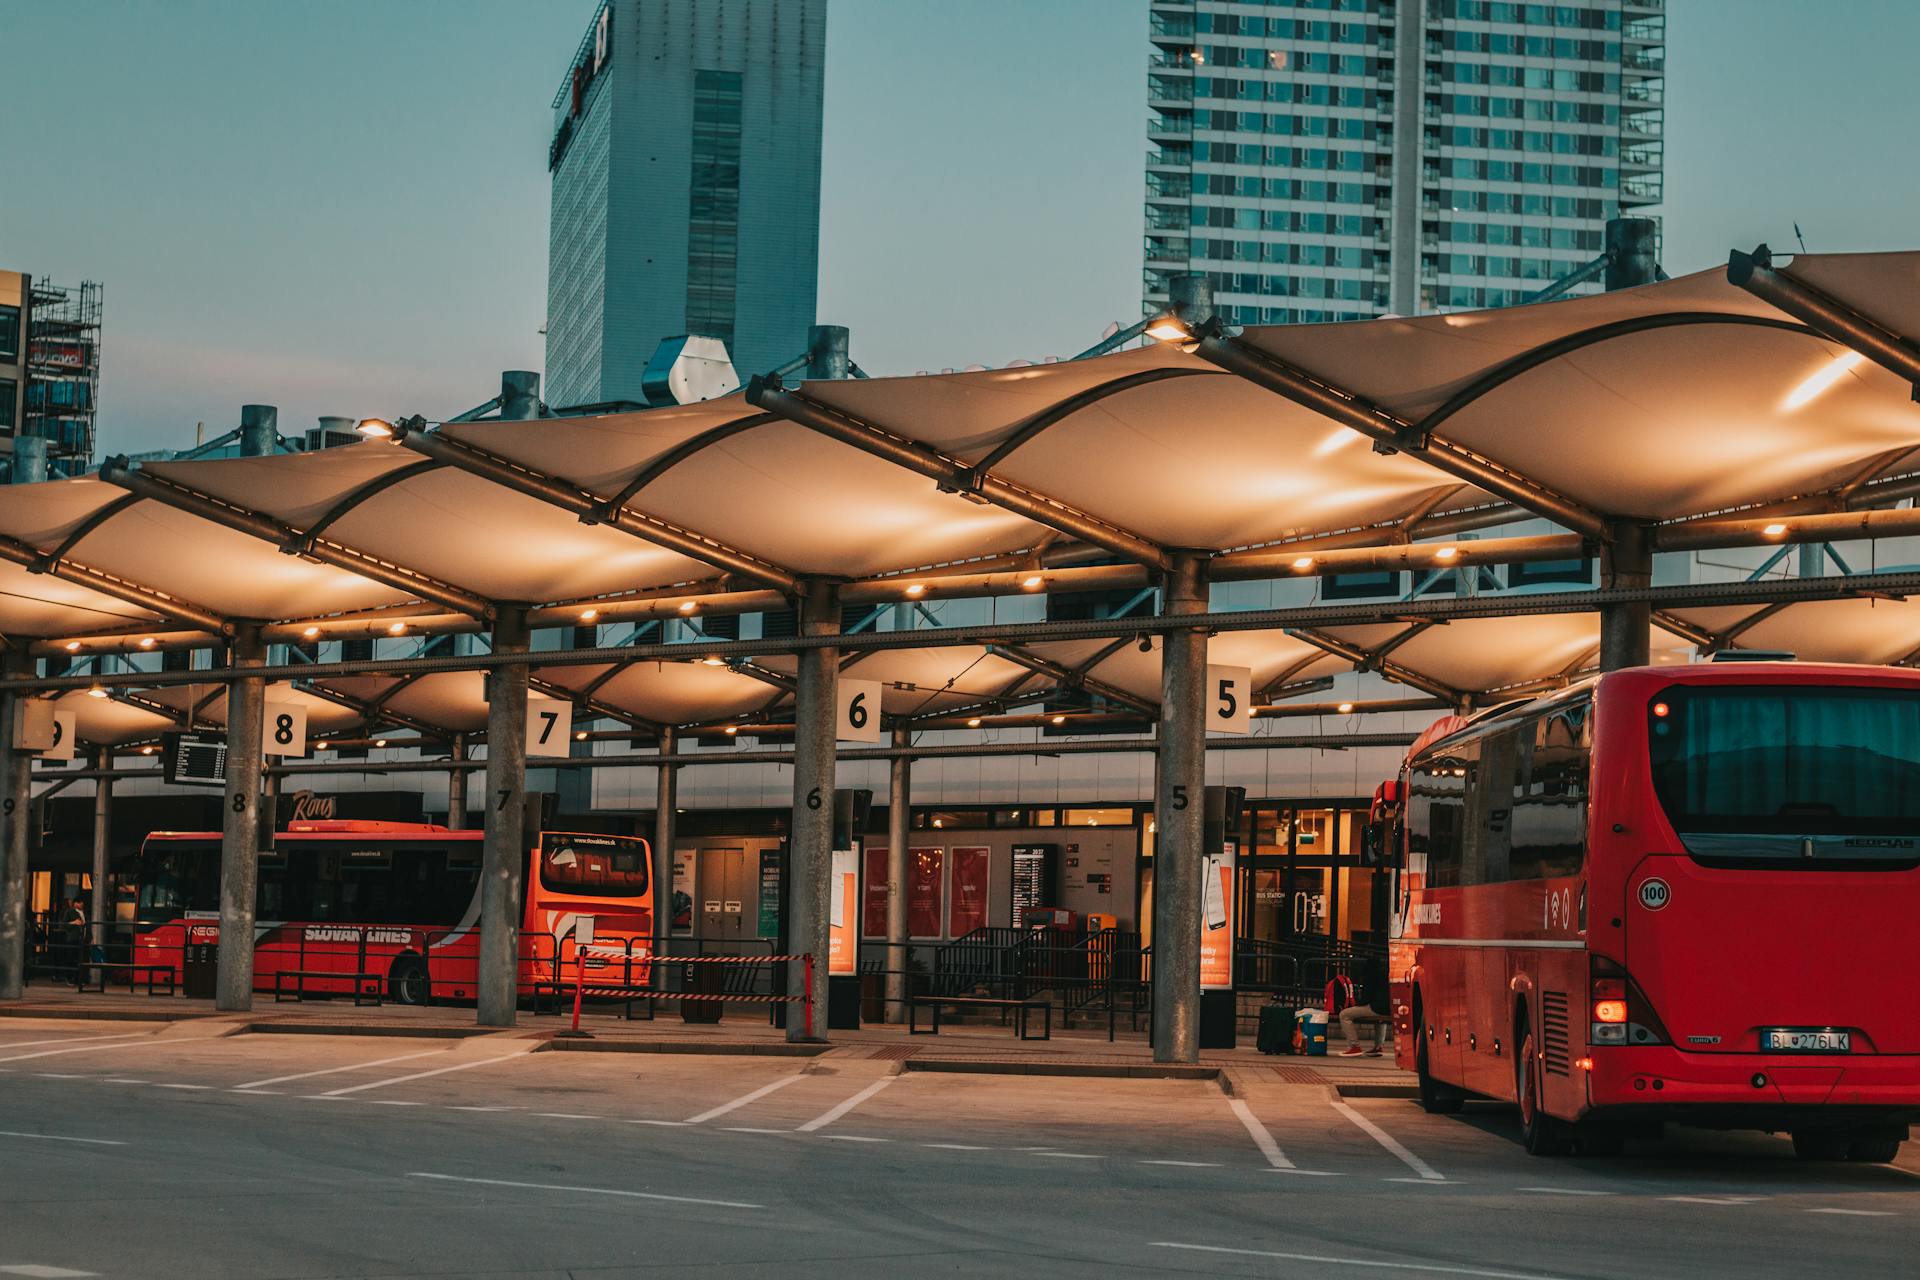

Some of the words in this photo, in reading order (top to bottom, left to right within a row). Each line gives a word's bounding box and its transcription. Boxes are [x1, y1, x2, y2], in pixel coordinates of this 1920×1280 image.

[849, 692, 867, 728] 6
[1218, 680, 1236, 719] 5
[275, 714, 293, 744] 8
[539, 712, 558, 744] 7
[4, 798, 15, 816] 9
[232, 793, 245, 812] 8
[497, 790, 511, 811] 7
[807, 787, 821, 810] 6
[1172, 785, 1188, 810] 5
[1645, 887, 1665, 900] 100
[366, 926, 412, 943] LINES
